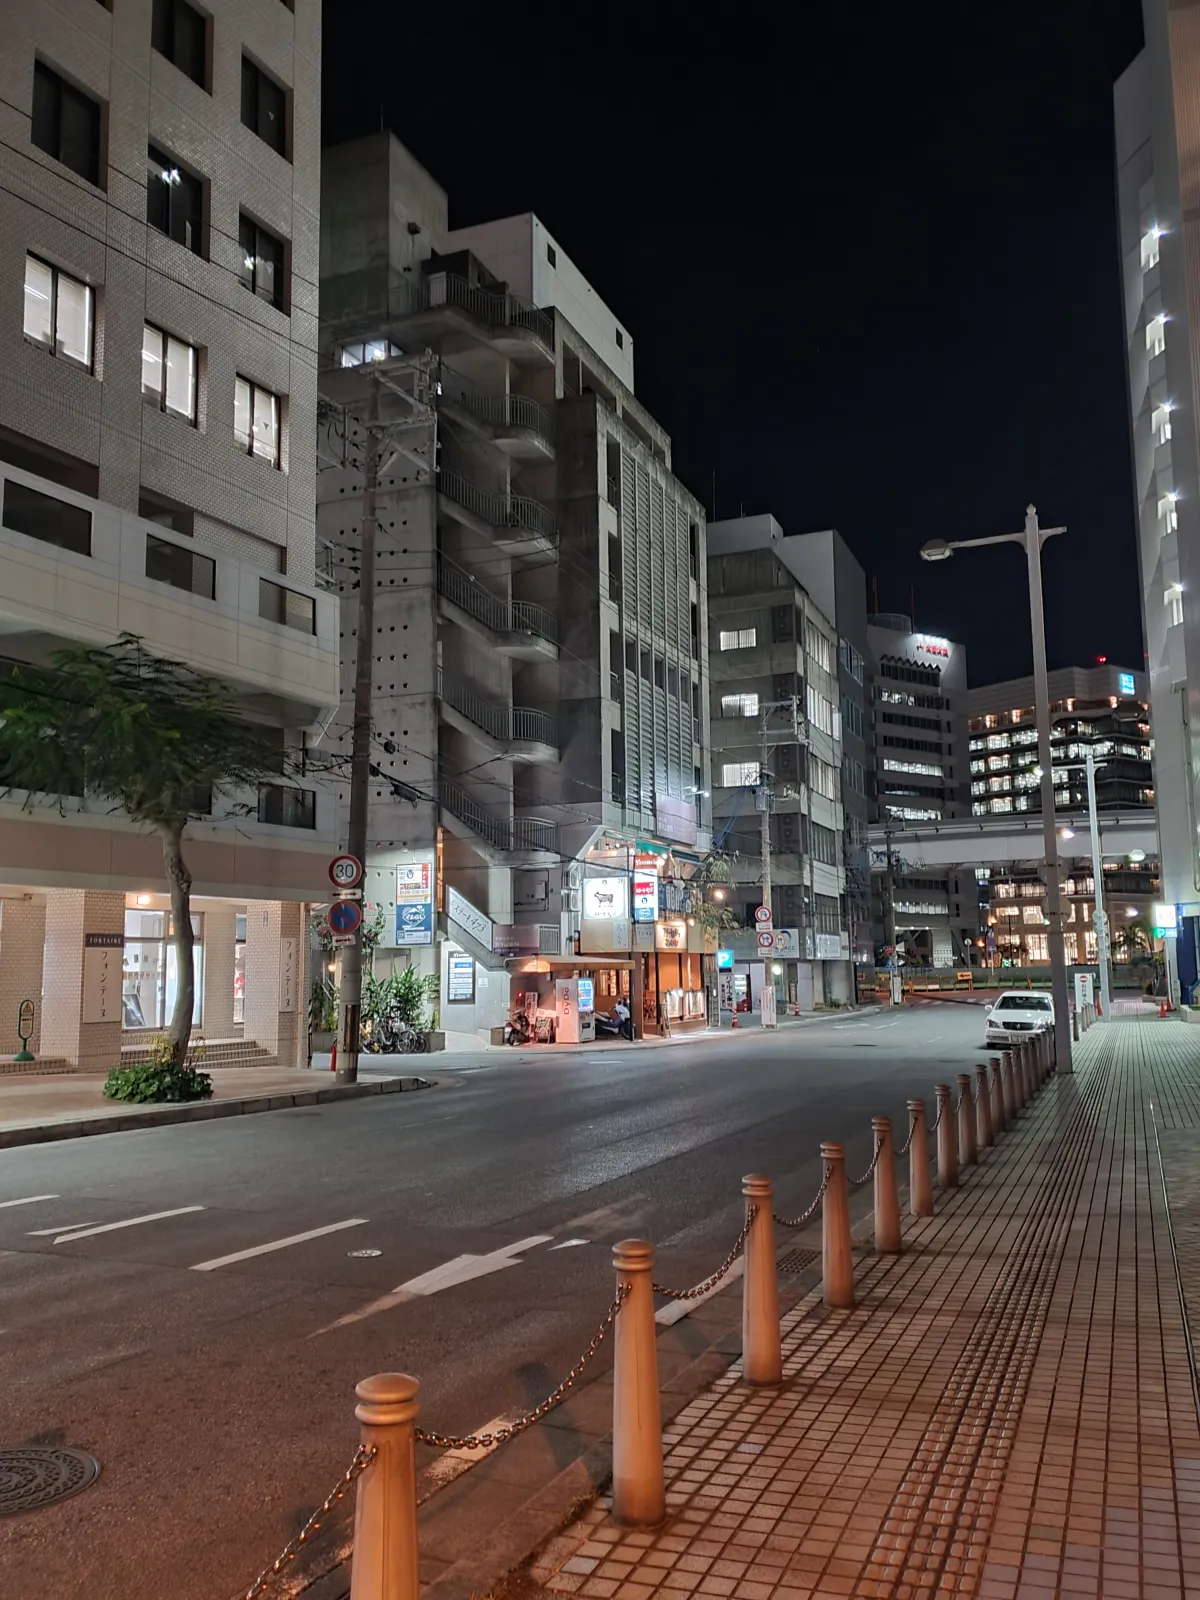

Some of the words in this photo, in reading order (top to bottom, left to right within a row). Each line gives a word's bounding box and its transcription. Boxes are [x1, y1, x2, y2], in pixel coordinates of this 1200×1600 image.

[336, 864, 354, 879] 30
[89, 936, 121, 945] FONTAINE
[718, 952, 729, 967] P
[99, 951, 109, 1018] フォンテーヌ
